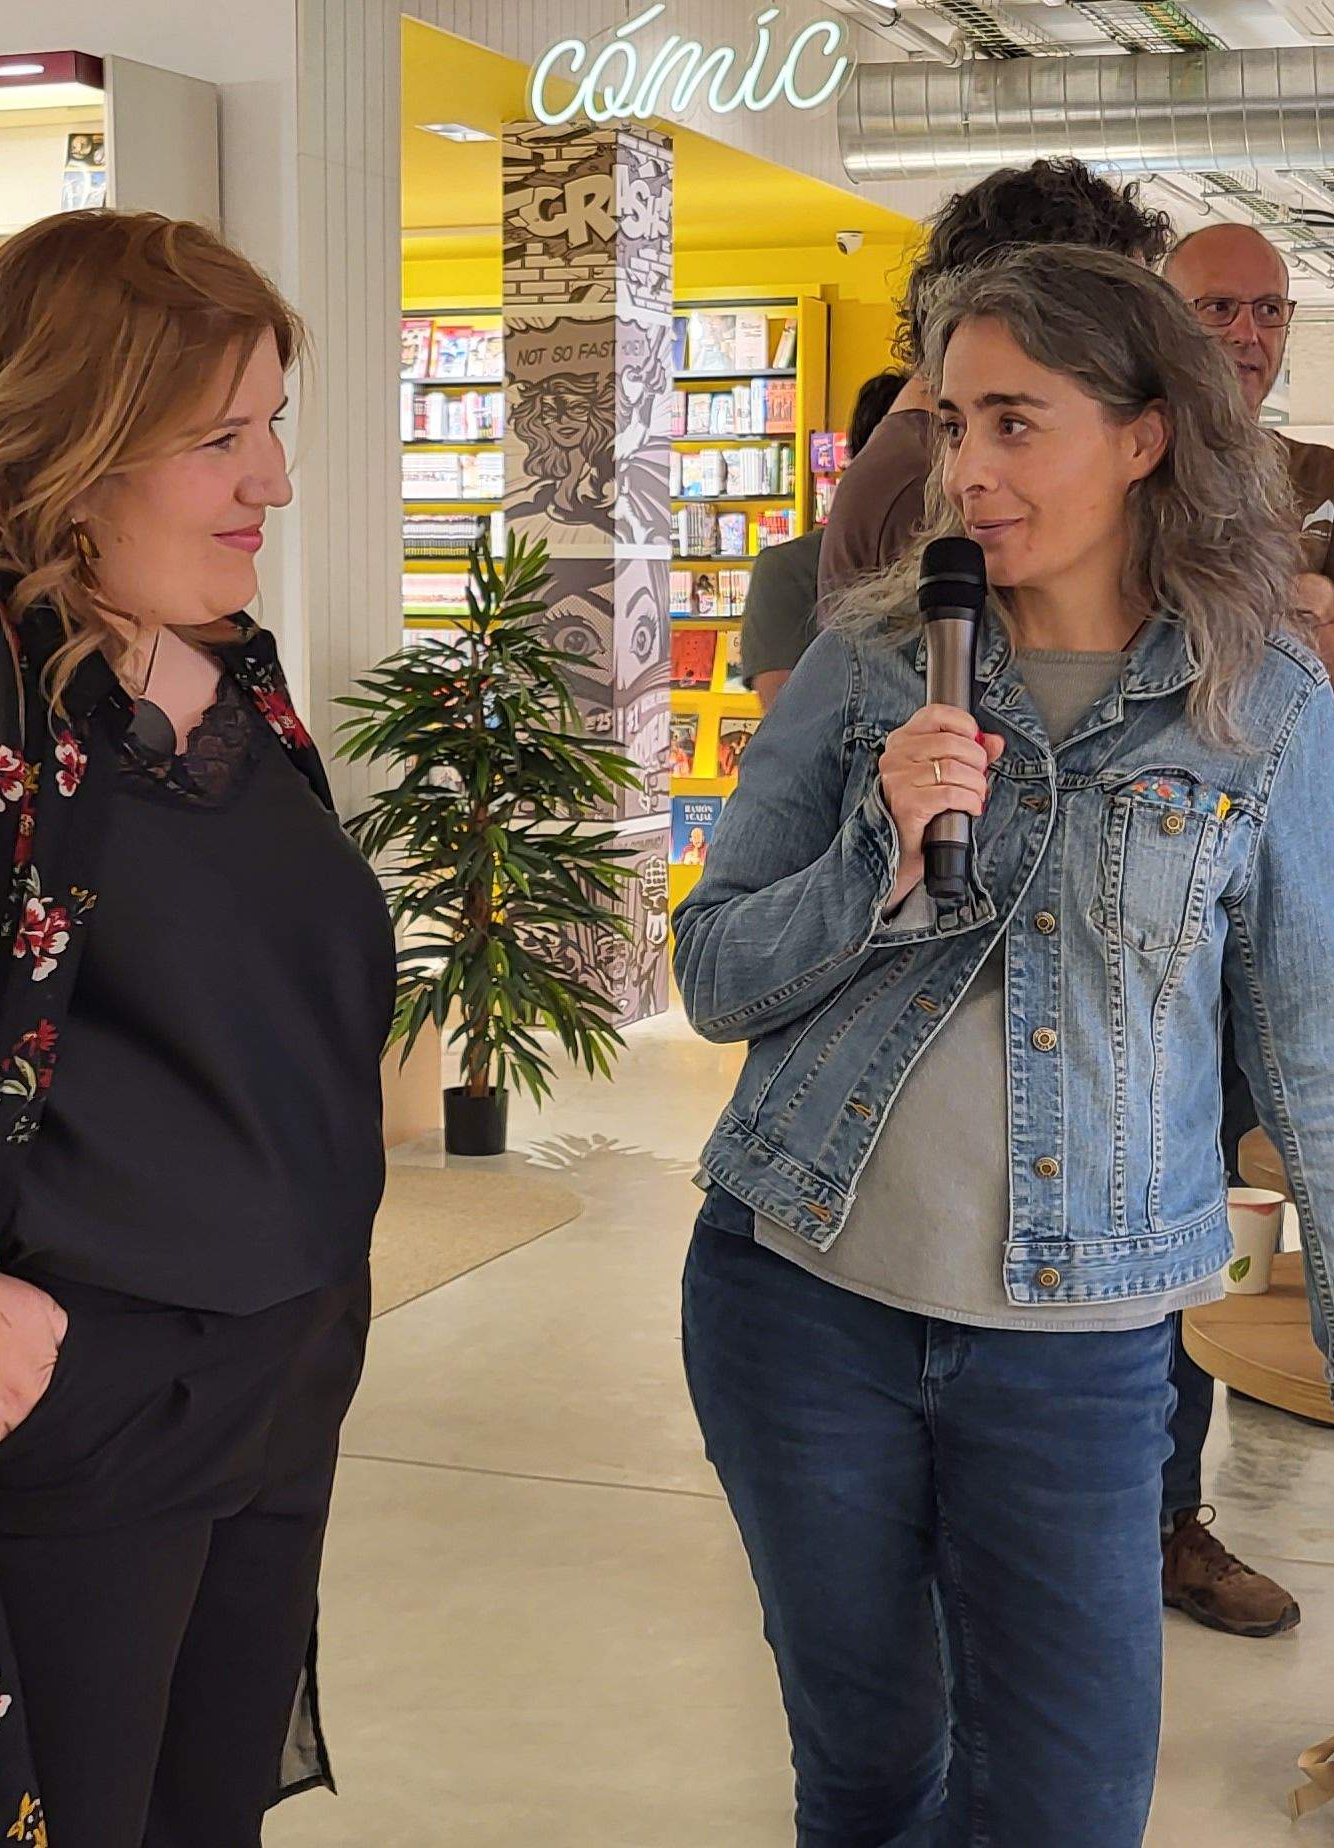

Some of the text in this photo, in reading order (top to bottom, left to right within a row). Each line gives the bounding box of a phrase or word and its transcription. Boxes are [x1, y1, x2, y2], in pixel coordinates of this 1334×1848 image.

[517, 348, 548, 367] NOT
[551, 345, 572, 363] SO
[577, 340, 617, 360] FAST
